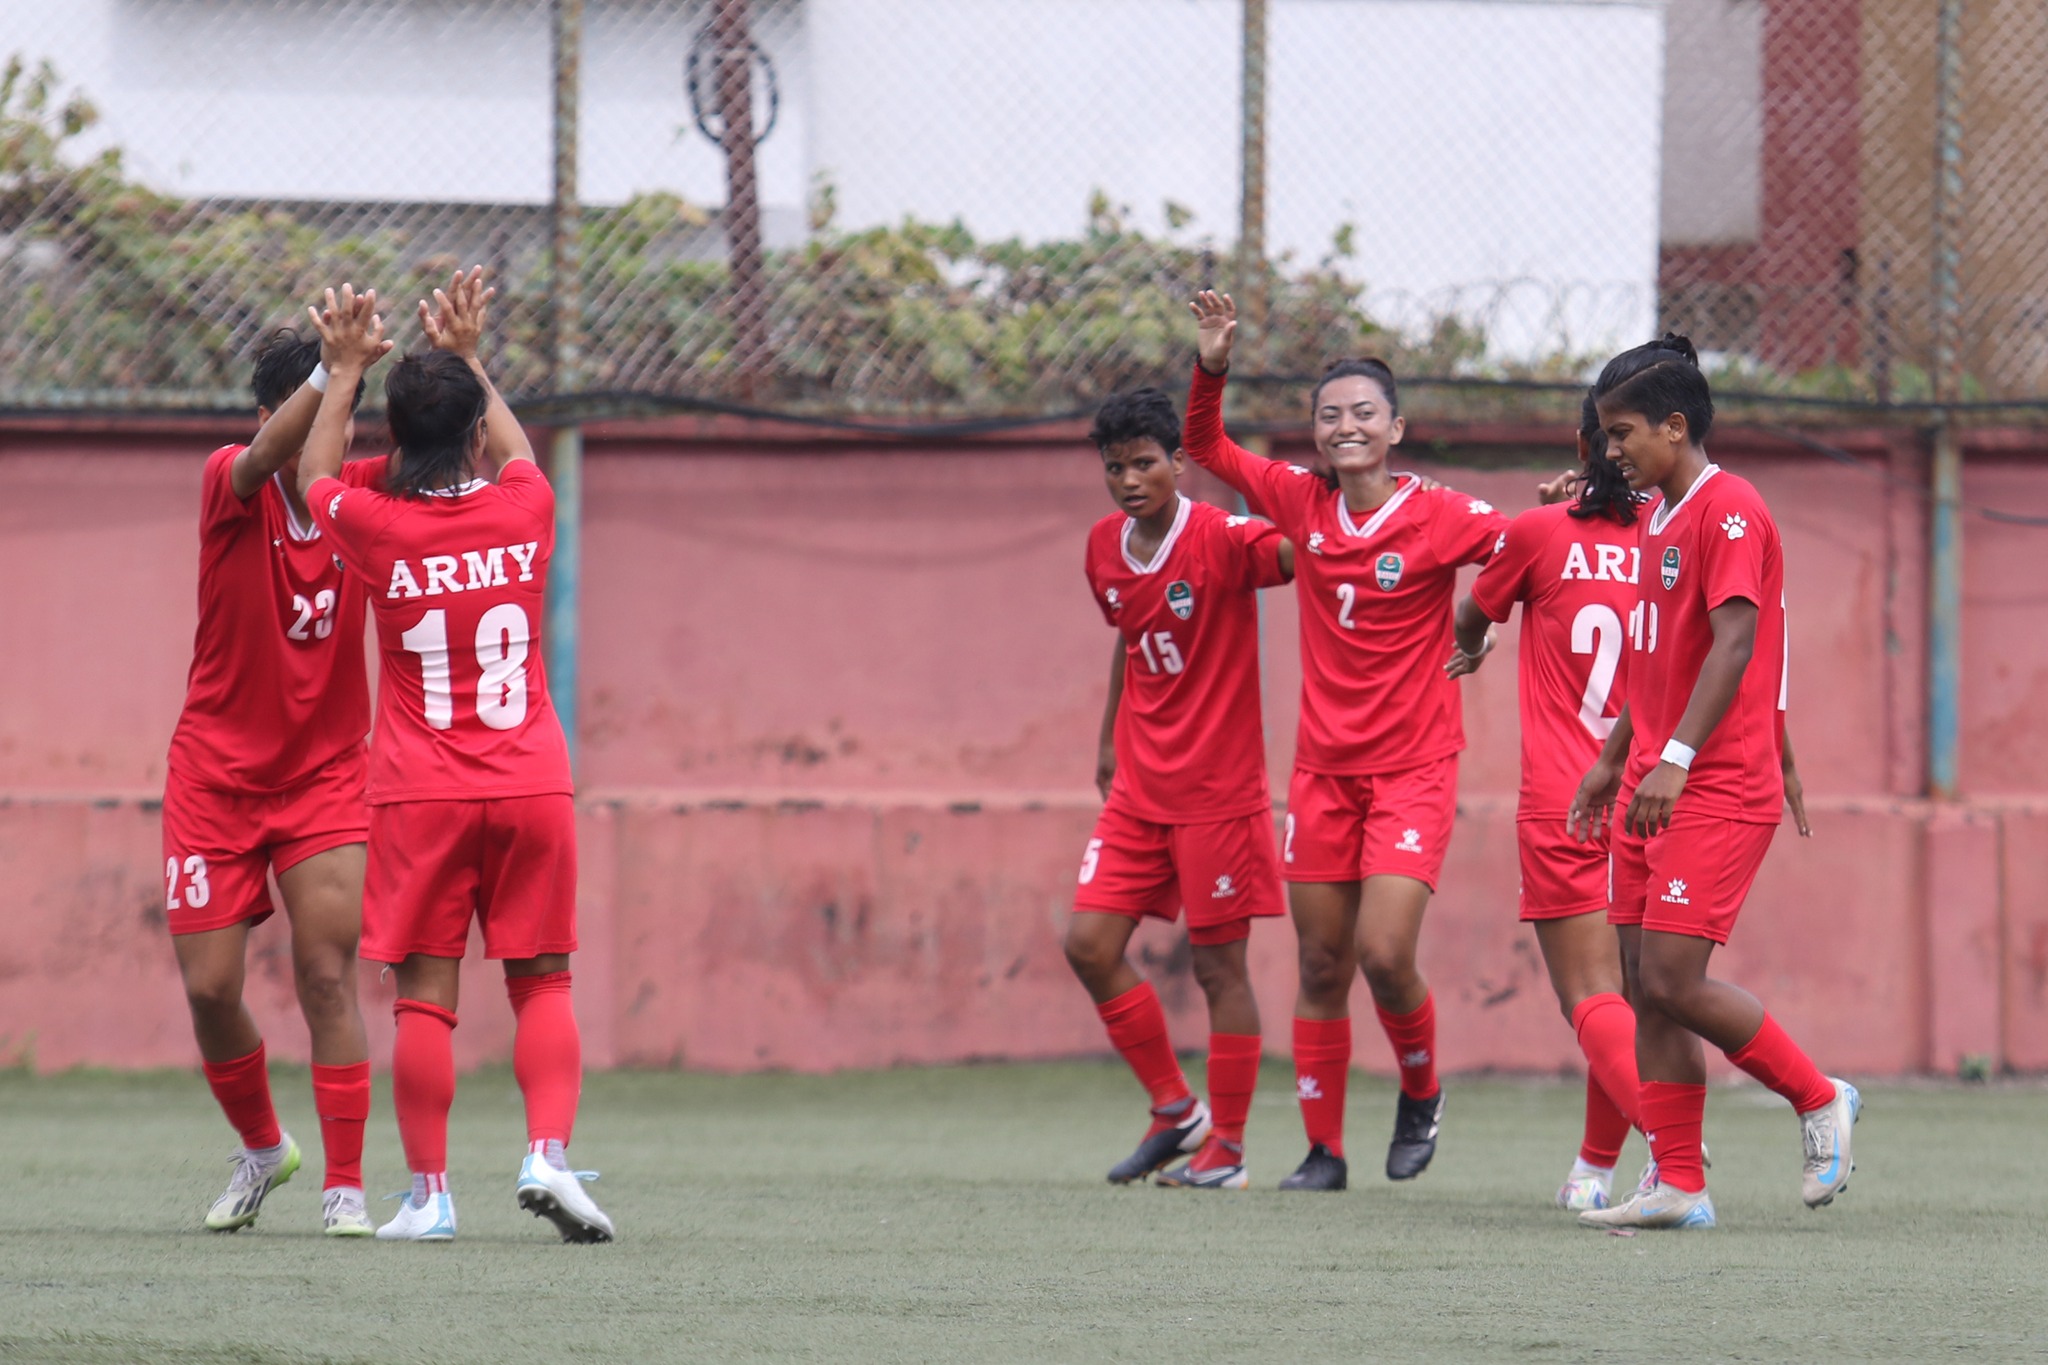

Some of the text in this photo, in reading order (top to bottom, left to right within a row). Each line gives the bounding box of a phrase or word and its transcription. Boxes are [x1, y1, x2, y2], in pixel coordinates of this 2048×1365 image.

[387, 541, 539, 599] ARMY
[286, 589, 336, 641] 23
[1336, 583, 1355, 630] 2
[402, 603, 530, 731] 18
[1139, 630, 1184, 675] 15
[1571, 603, 1635, 740] 2
[1284, 812, 1295, 864] 2
[166, 855, 210, 911] 23
[1660, 893, 1690, 905] KELME
